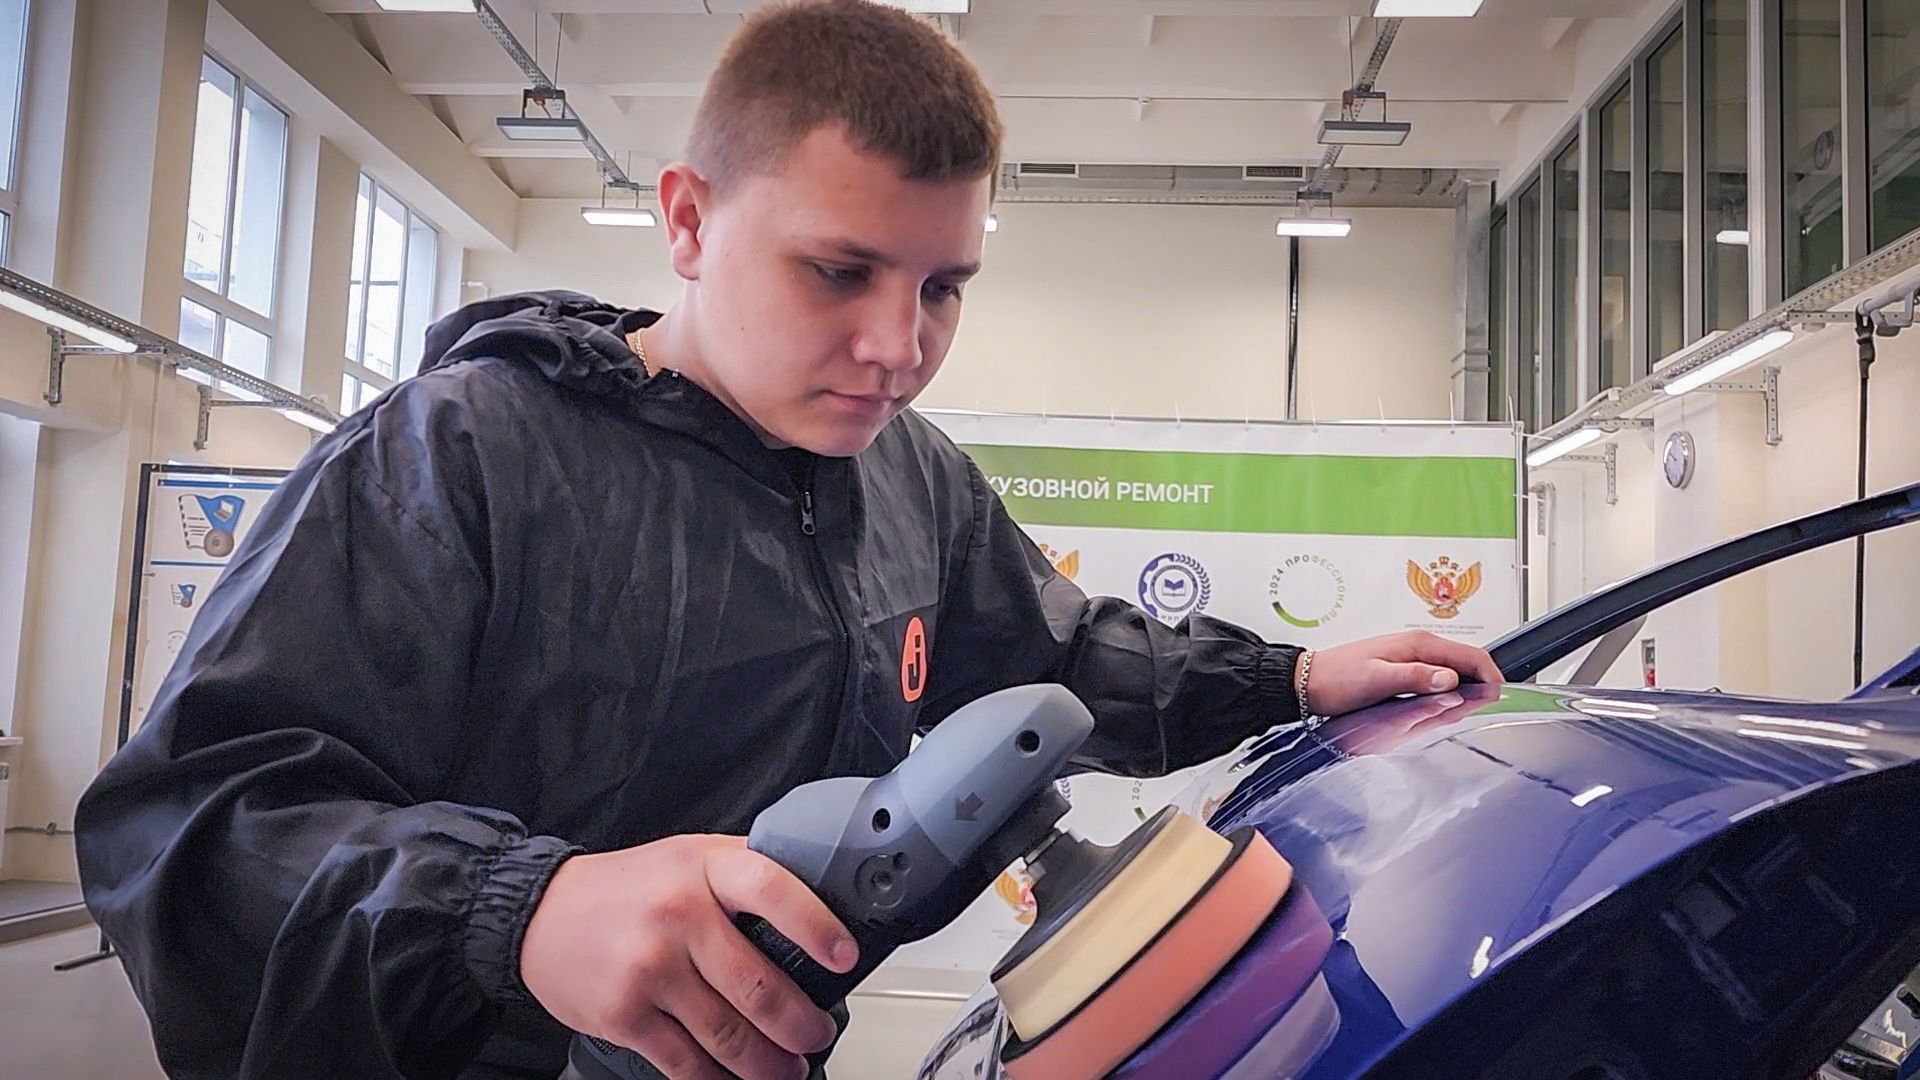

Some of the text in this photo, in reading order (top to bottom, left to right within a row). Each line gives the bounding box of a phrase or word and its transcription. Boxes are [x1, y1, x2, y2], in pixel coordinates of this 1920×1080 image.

[1116, 482, 1214, 503] РЕМОНТ
[1269, 568, 1284, 596] 2024
[1131, 780, 1143, 801] 202
